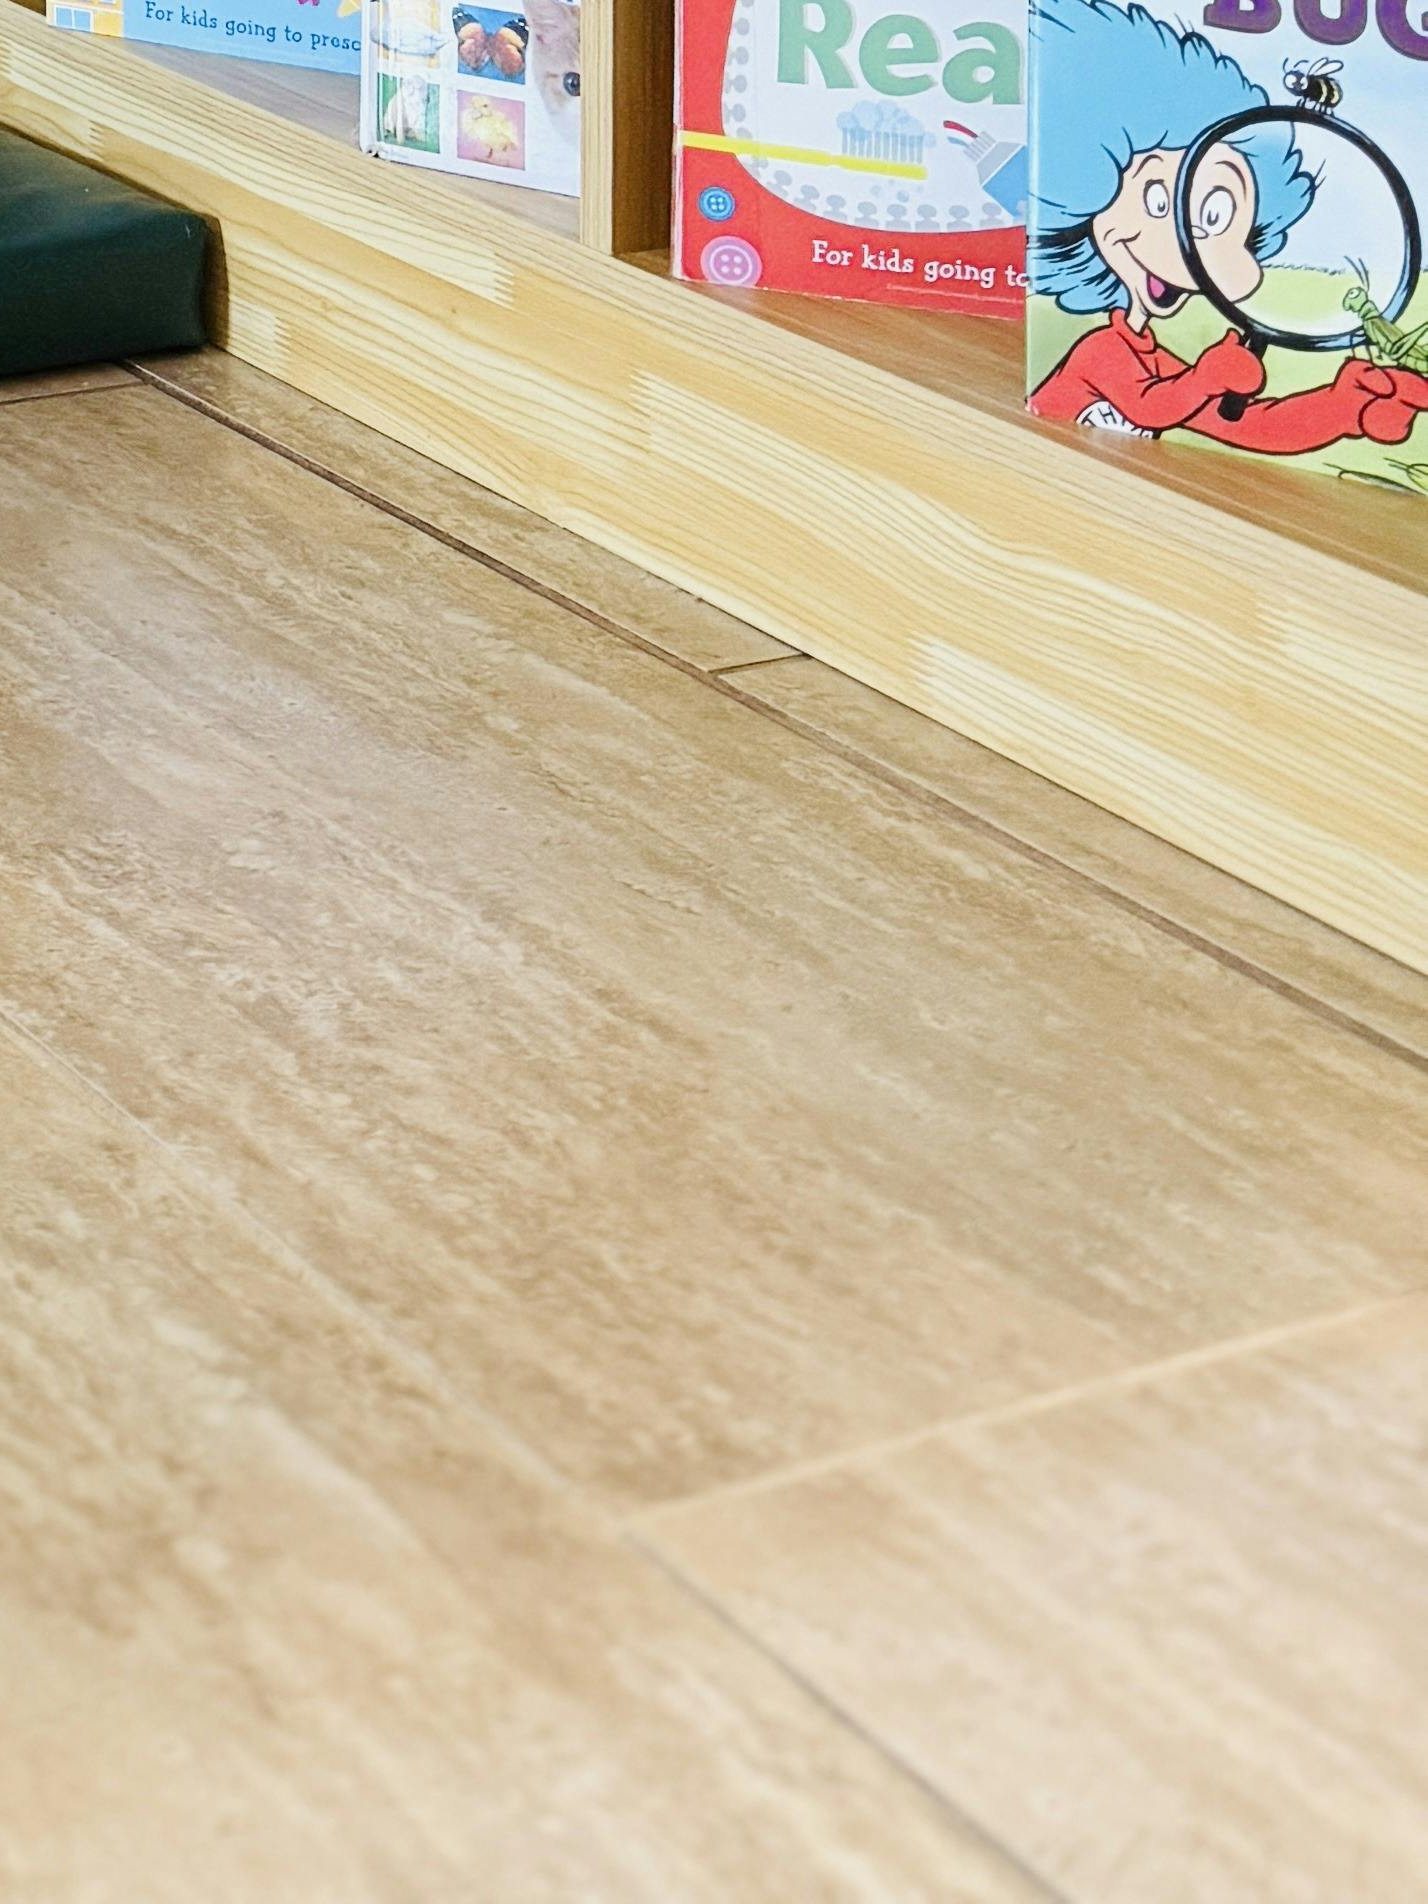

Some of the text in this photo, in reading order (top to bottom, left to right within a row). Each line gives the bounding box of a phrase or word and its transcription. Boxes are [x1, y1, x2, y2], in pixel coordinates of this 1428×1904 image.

[145, 0, 174, 22] For
[180, 6, 218, 30] kids
[225, 19, 277, 43] going
[284, 25, 302, 43] to
[811, 239, 854, 266] For
[861, 244, 915, 273] kids
[924, 259, 996, 288] going
